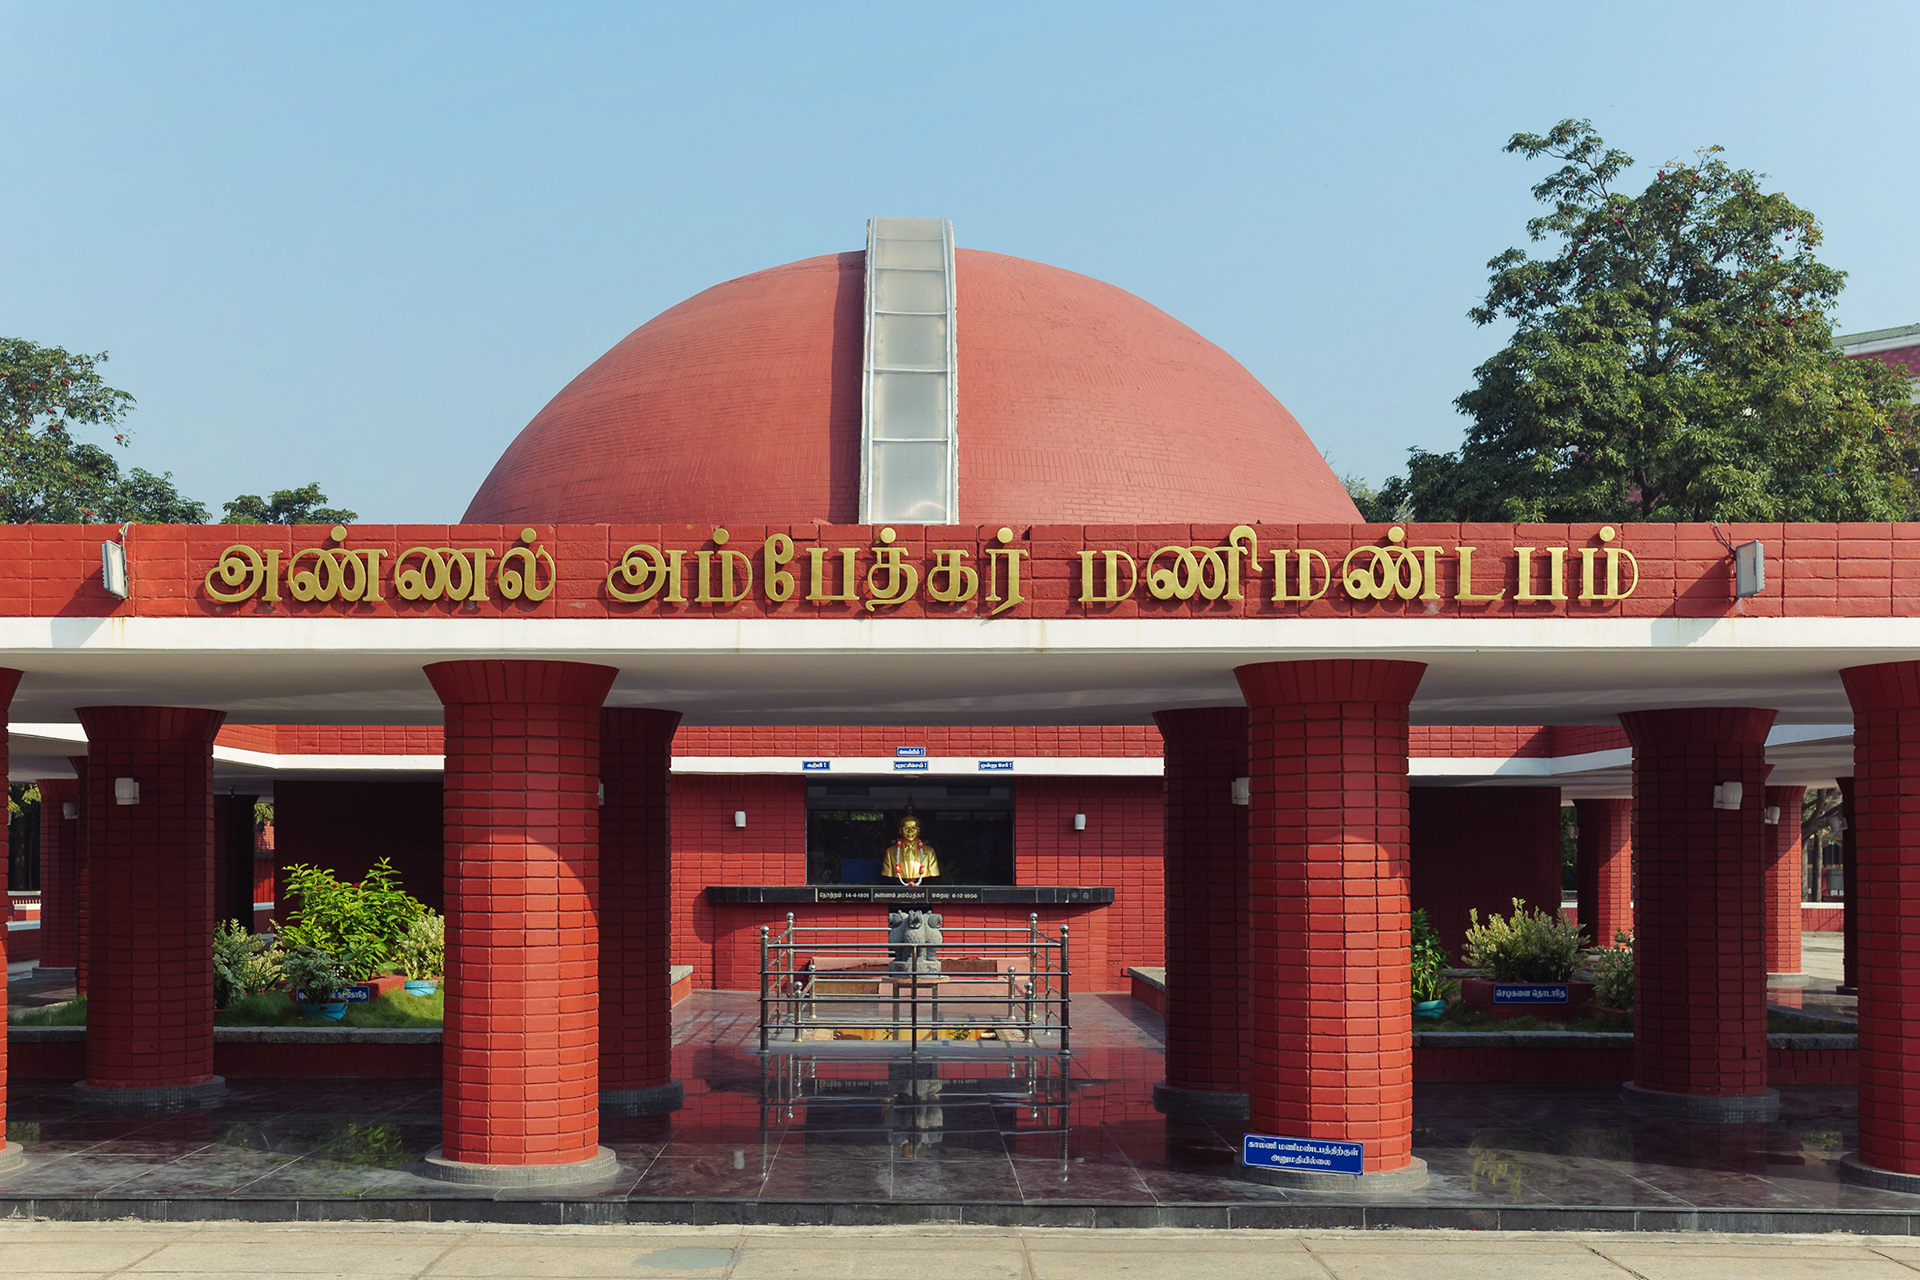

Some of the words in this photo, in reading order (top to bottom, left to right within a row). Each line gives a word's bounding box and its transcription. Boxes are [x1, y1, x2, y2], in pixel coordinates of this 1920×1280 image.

[204, 525, 556, 602] அண்ணல்
[606, 526, 1029, 616] அம்பேத்கர்
[1076, 525, 1640, 602] மணிமண்டபம்
[1248, 1141, 1277, 1149] காலணி
[1271, 1154, 1331, 1165] அனுமதியில்லை
